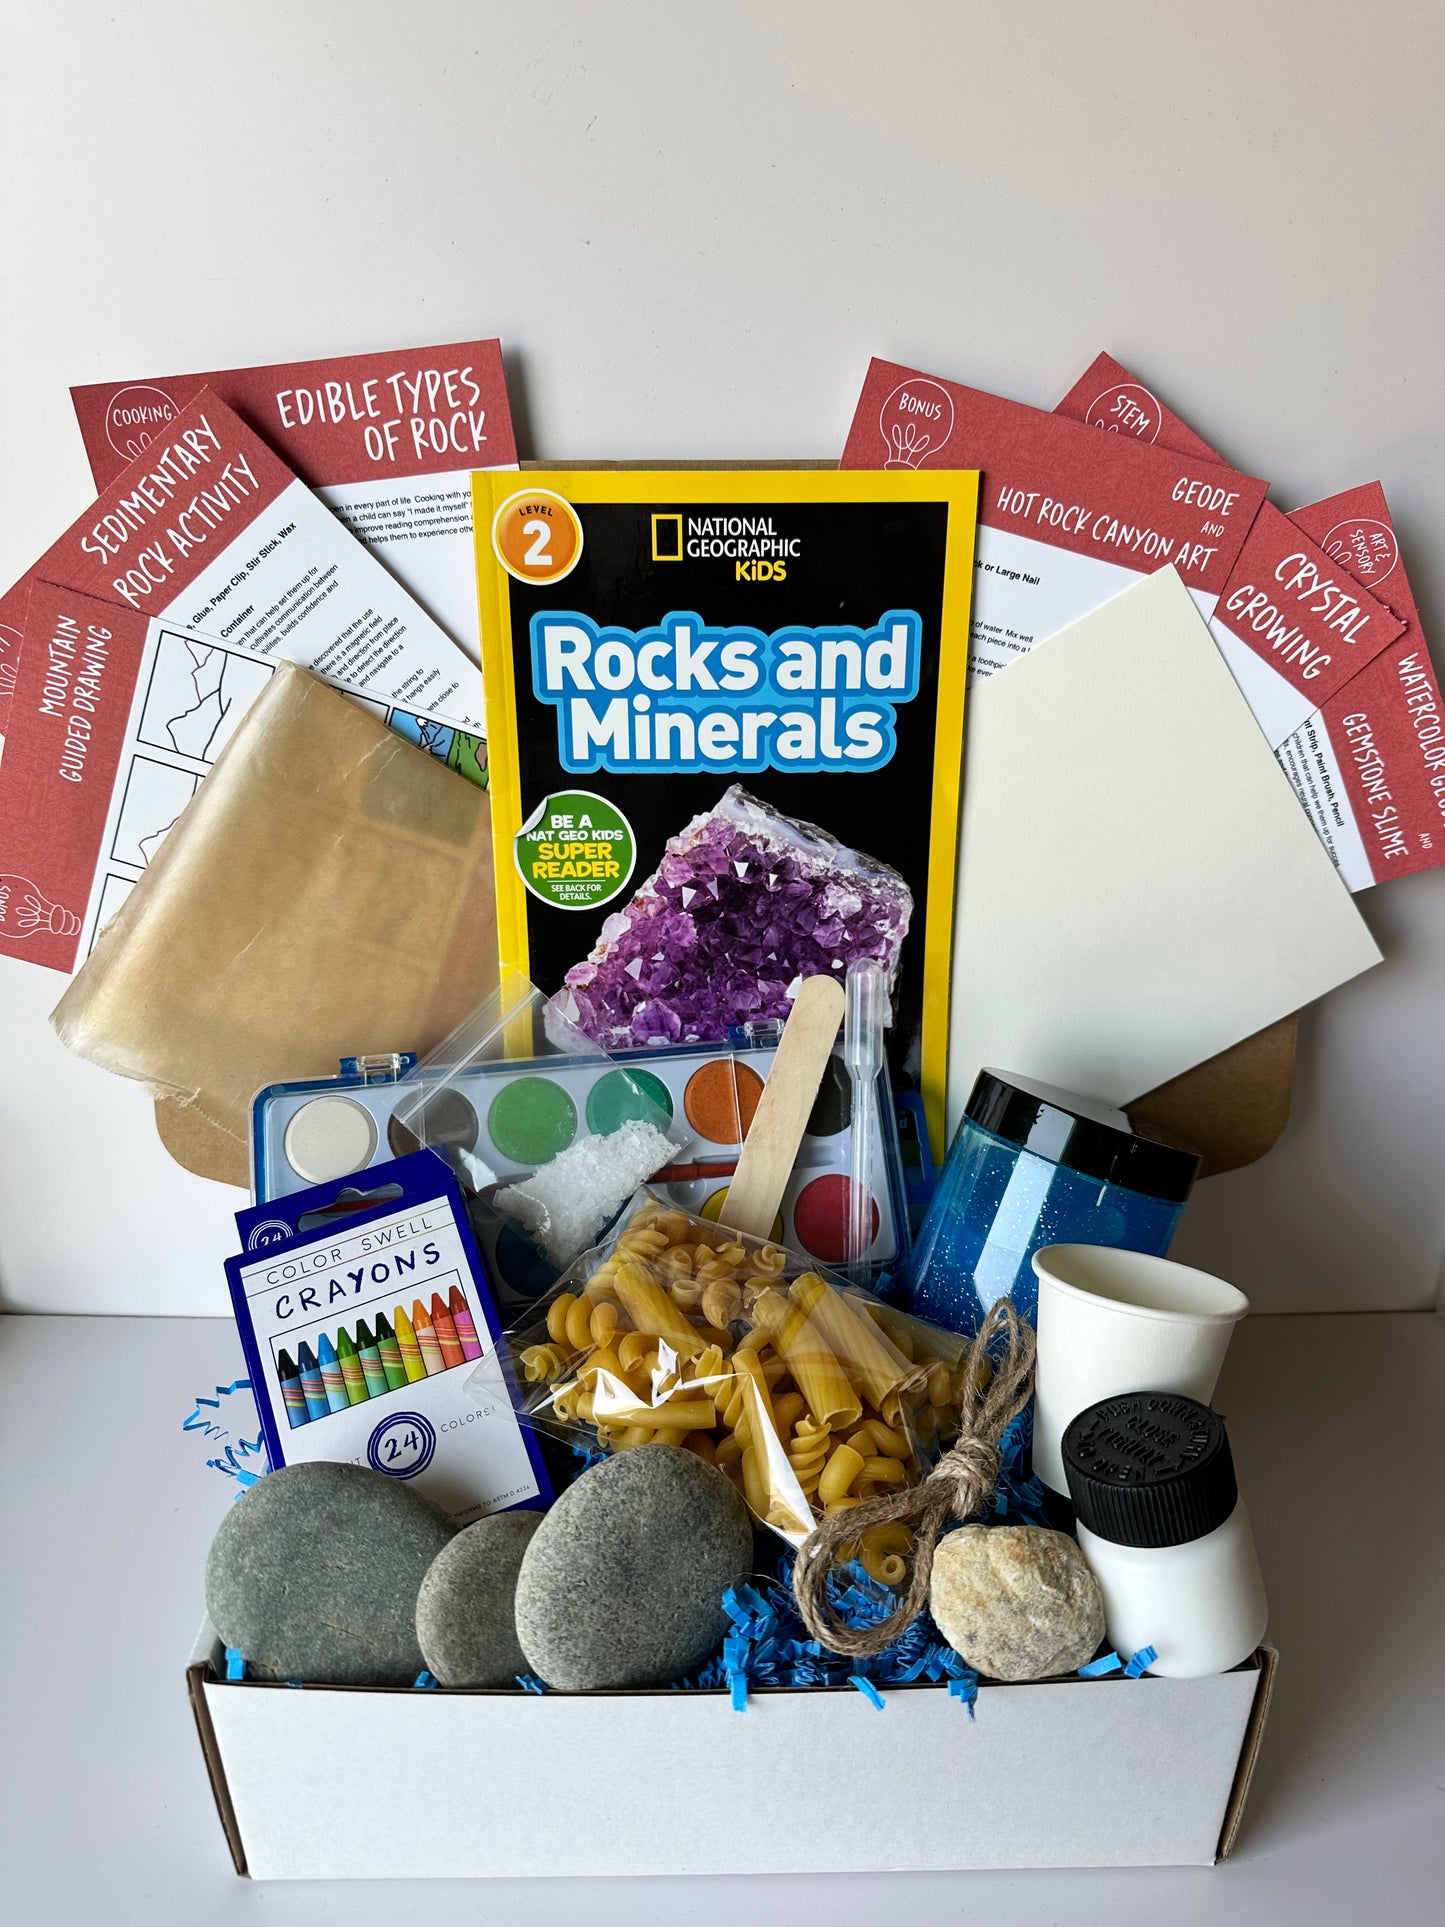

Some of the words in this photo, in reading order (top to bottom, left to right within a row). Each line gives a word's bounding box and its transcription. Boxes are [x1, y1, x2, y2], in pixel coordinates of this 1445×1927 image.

[113, 404, 172, 426] COOKING
[276, 380, 379, 428] EDIBLE
[386, 366, 480, 414] TYPES
[899, 393, 942, 420] BONUS
[1110, 394, 1150, 436] STEM
[364, 420, 402, 462] OF
[410, 411, 488, 460] ROCK
[82, 414, 221, 564] SEDIMENTARY
[376, 500, 390, 509] part
[415, 494, 444, 503] Cooking
[446, 491, 460, 499] with
[1172, 477, 1240, 516] GEODE
[112, 542, 174, 608] ROCK
[166, 454, 259, 558] ACTIVITY
[359, 513, 376, 521] child
[414, 506, 434, 514] made
[385, 521, 412, 529] reading
[414, 515, 469, 526] comprehension
[519, 505, 553, 517] LEVEL
[688, 518, 777, 536] NATIONAL
[997, 486, 1040, 518] HOT
[1038, 498, 1091, 534] ROCK
[1092, 515, 1176, 558] CANYON
[1175, 542, 1218, 572] ART
[1200, 520, 1224, 537] AND
[418, 528, 457, 538] experience
[523, 520, 552, 566] 2
[687, 539, 800, 558] GEOGRAPHIC
[1350, 529, 1376, 574] SENSORY
[1369, 534, 1388, 551] ART
[193, 607, 213, 623] Glue,
[210, 585, 232, 606] Paper
[231, 572, 249, 586] Clip,
[246, 557, 260, 570] Stir
[259, 540, 282, 558] Stick,
[278, 523, 296, 538] Wax
[996, 566, 1020, 580] Large
[1022, 574, 1040, 585] Nail
[244, 626, 257, 638] that
[256, 617, 267, 627] can
[265, 605, 279, 618] help
[286, 583, 302, 597] them
[308, 567, 318, 576] for
[250, 625, 276, 650] cultivates
[275, 587, 315, 626] communication
[313, 565, 338, 588] between
[280, 620, 298, 636] builds
[298, 592, 327, 620] confidence
[326, 580, 338, 593] and
[1274, 553, 1372, 645] CRYSTAL
[221, 605, 254, 637] Container
[314, 637, 343, 666] discovered
[341, 627, 354, 639] that
[352, 619, 362, 629] the
[362, 609, 373, 620] use
[1226, 584, 1331, 680] GROWING
[39, 616, 76, 717] MOUNTAIN
[320, 660, 336, 675] there
[345, 628, 371, 652] magnetic
[369, 615, 382, 629] field
[337, 663, 348, 676] and
[348, 644, 371, 666] direction
[369, 631, 384, 644] from
[383, 617, 398, 634] place
[357, 655, 375, 673] detect
[373, 648, 383, 657] the
[383, 626, 406, 648] direction
[544, 626, 759, 691] Rocks
[776, 625, 908, 689] and
[74, 626, 112, 713] DRAWING
[359, 674, 370, 687] and
[369, 655, 393, 677] navigate
[392, 688, 402, 698] the
[402, 674, 418, 690] string
[406, 684, 424, 700] hangs
[424, 669, 440, 685] easily
[438, 688, 453, 702] close
[1398, 652, 1444, 771] WATERCOLOR
[572, 694, 882, 759] Minerals
[60, 716, 92, 782] GUIDED
[1308, 730, 1318, 752] Strip,
[1314, 753, 1327, 774] Paint
[1322, 775, 1335, 801] Brush,
[1331, 802, 1344, 826] Pencil
[1342, 713, 1392, 804] GEMSTONE
[1372, 806, 1408, 859] SLIME
[526, 831, 554, 841] NAT
[558, 830, 588, 840] GEO
[592, 830, 623, 840] KIDS
[551, 815, 574, 828] BE
[579, 814, 592, 828] A
[1418, 832, 1432, 848] AND
[532, 861, 620, 879] READER
[538, 843, 612, 860] SUPER
[552, 884, 565, 892] SEE
[566, 884, 586, 892] BACK
[266, 1248, 342, 1284] COLOR
[360, 1216, 434, 1251] SWELL
[276, 1243, 440, 1320] CRAYONS
[384, 1431, 419, 1462] 24
[493, 1493, 508, 1504] ASTM
